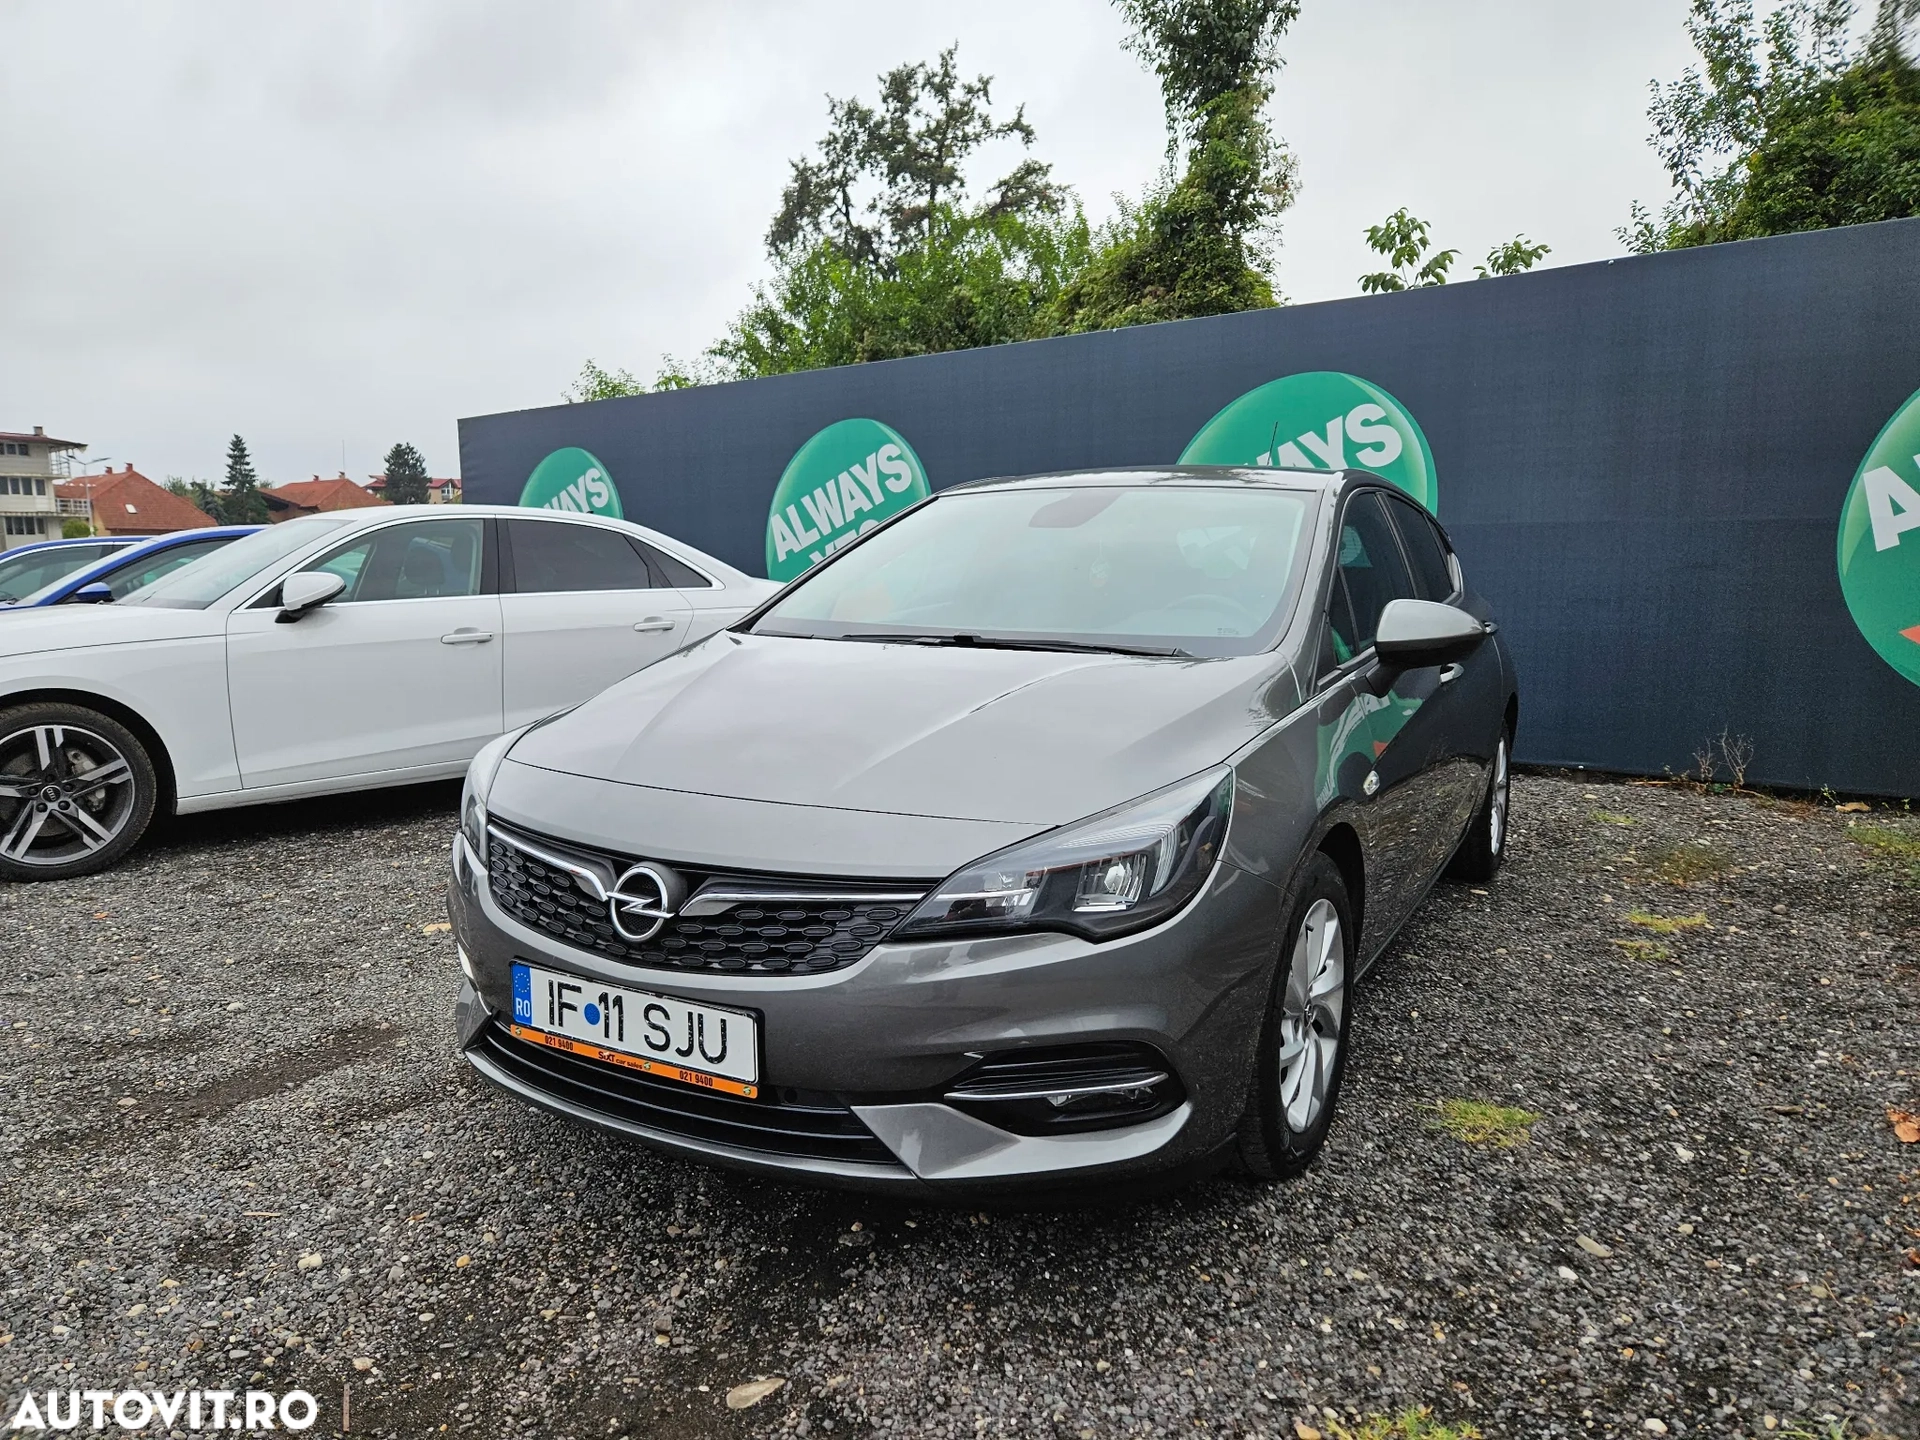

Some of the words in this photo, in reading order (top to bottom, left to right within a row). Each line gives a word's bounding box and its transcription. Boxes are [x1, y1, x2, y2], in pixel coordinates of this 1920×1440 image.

[771, 443, 912, 563] ALWAYS
[515, 997, 531, 1018] RO
[548, 979, 582, 1028] IF
[598, 991, 624, 1042] 11
[643, 1003, 727, 1065] SJU
[544, 1035, 556, 1046] 021
[558, 1039, 574, 1051] 9400
[679, 1070, 692, 1082] 021
[695, 1074, 713, 1087] 9400
